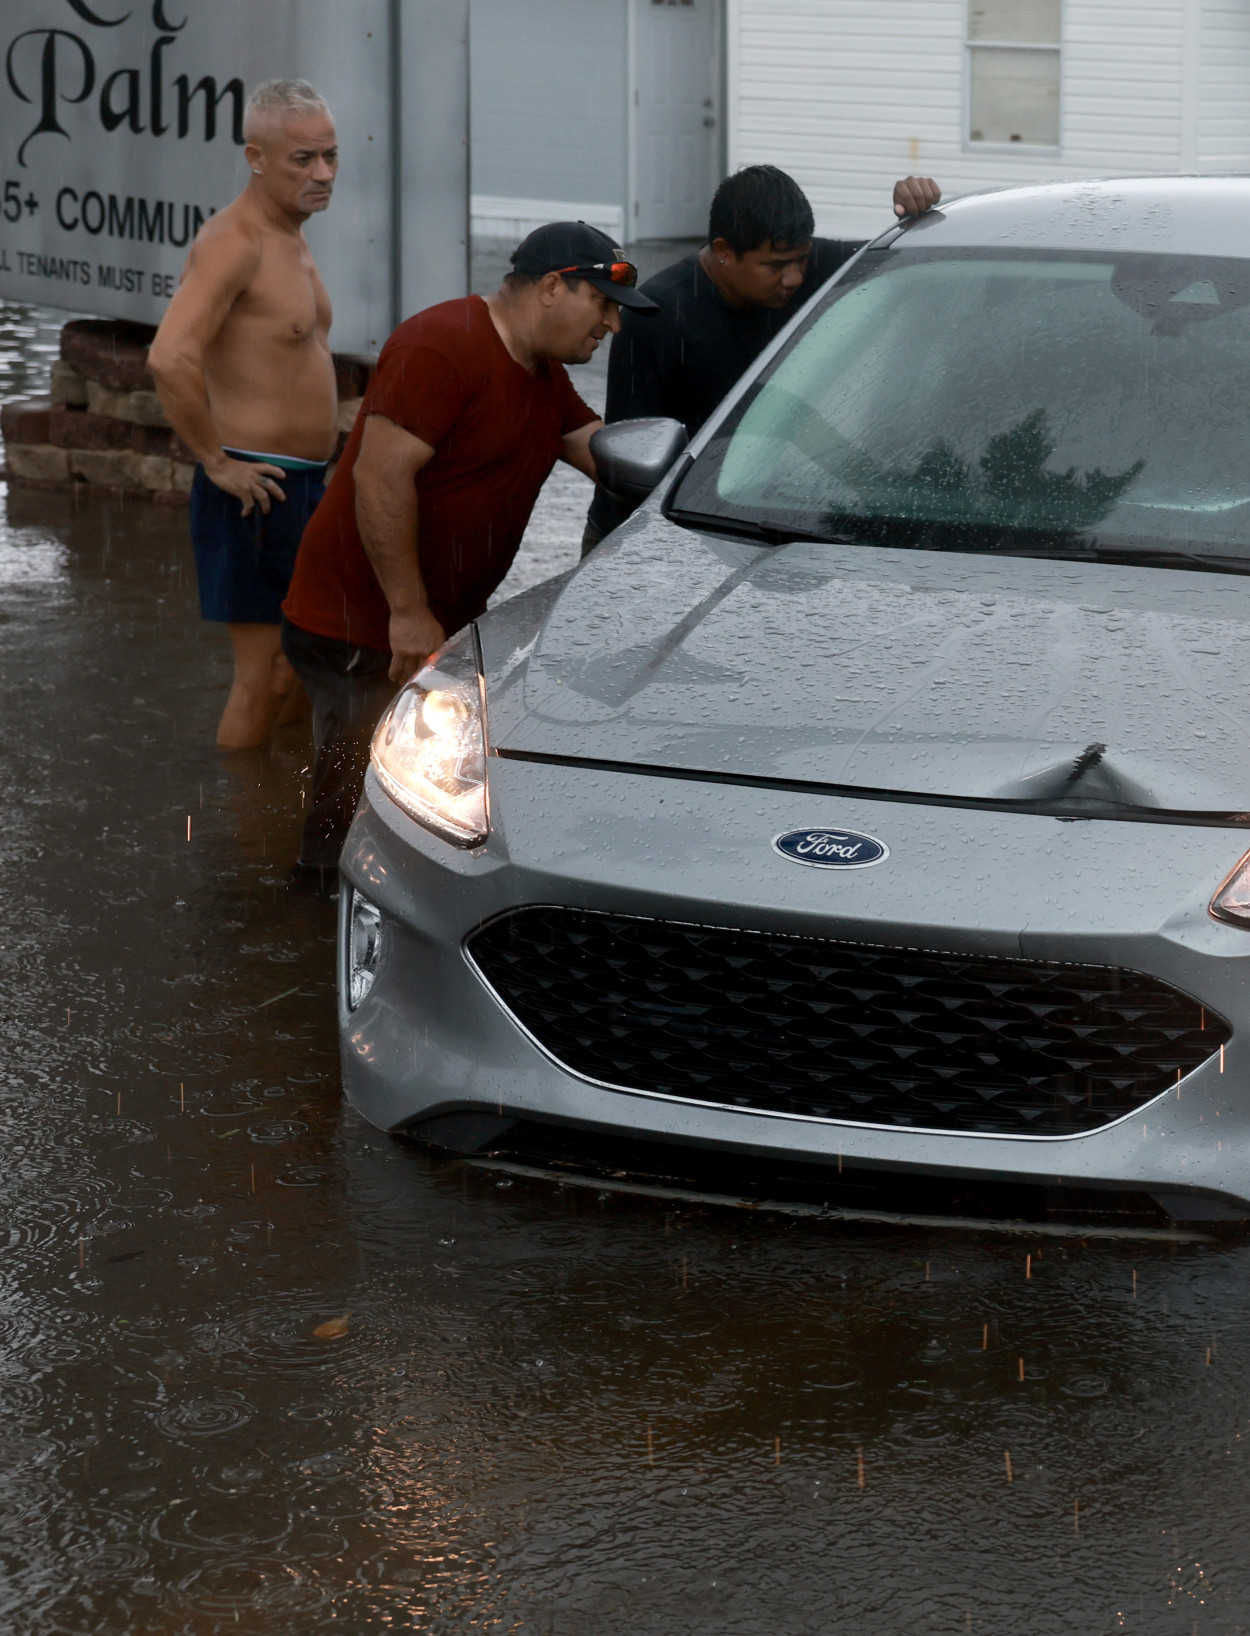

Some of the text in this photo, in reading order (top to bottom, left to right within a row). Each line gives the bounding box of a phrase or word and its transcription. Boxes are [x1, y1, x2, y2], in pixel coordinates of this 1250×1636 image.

[6, 28, 246, 168] Palm
[1, 180, 39, 223] 5+
[17, 251, 91, 285] TENANTS
[98, 265, 145, 293] MUST
[152, 273, 174, 298] BE
[796, 832, 862, 859] Ford
